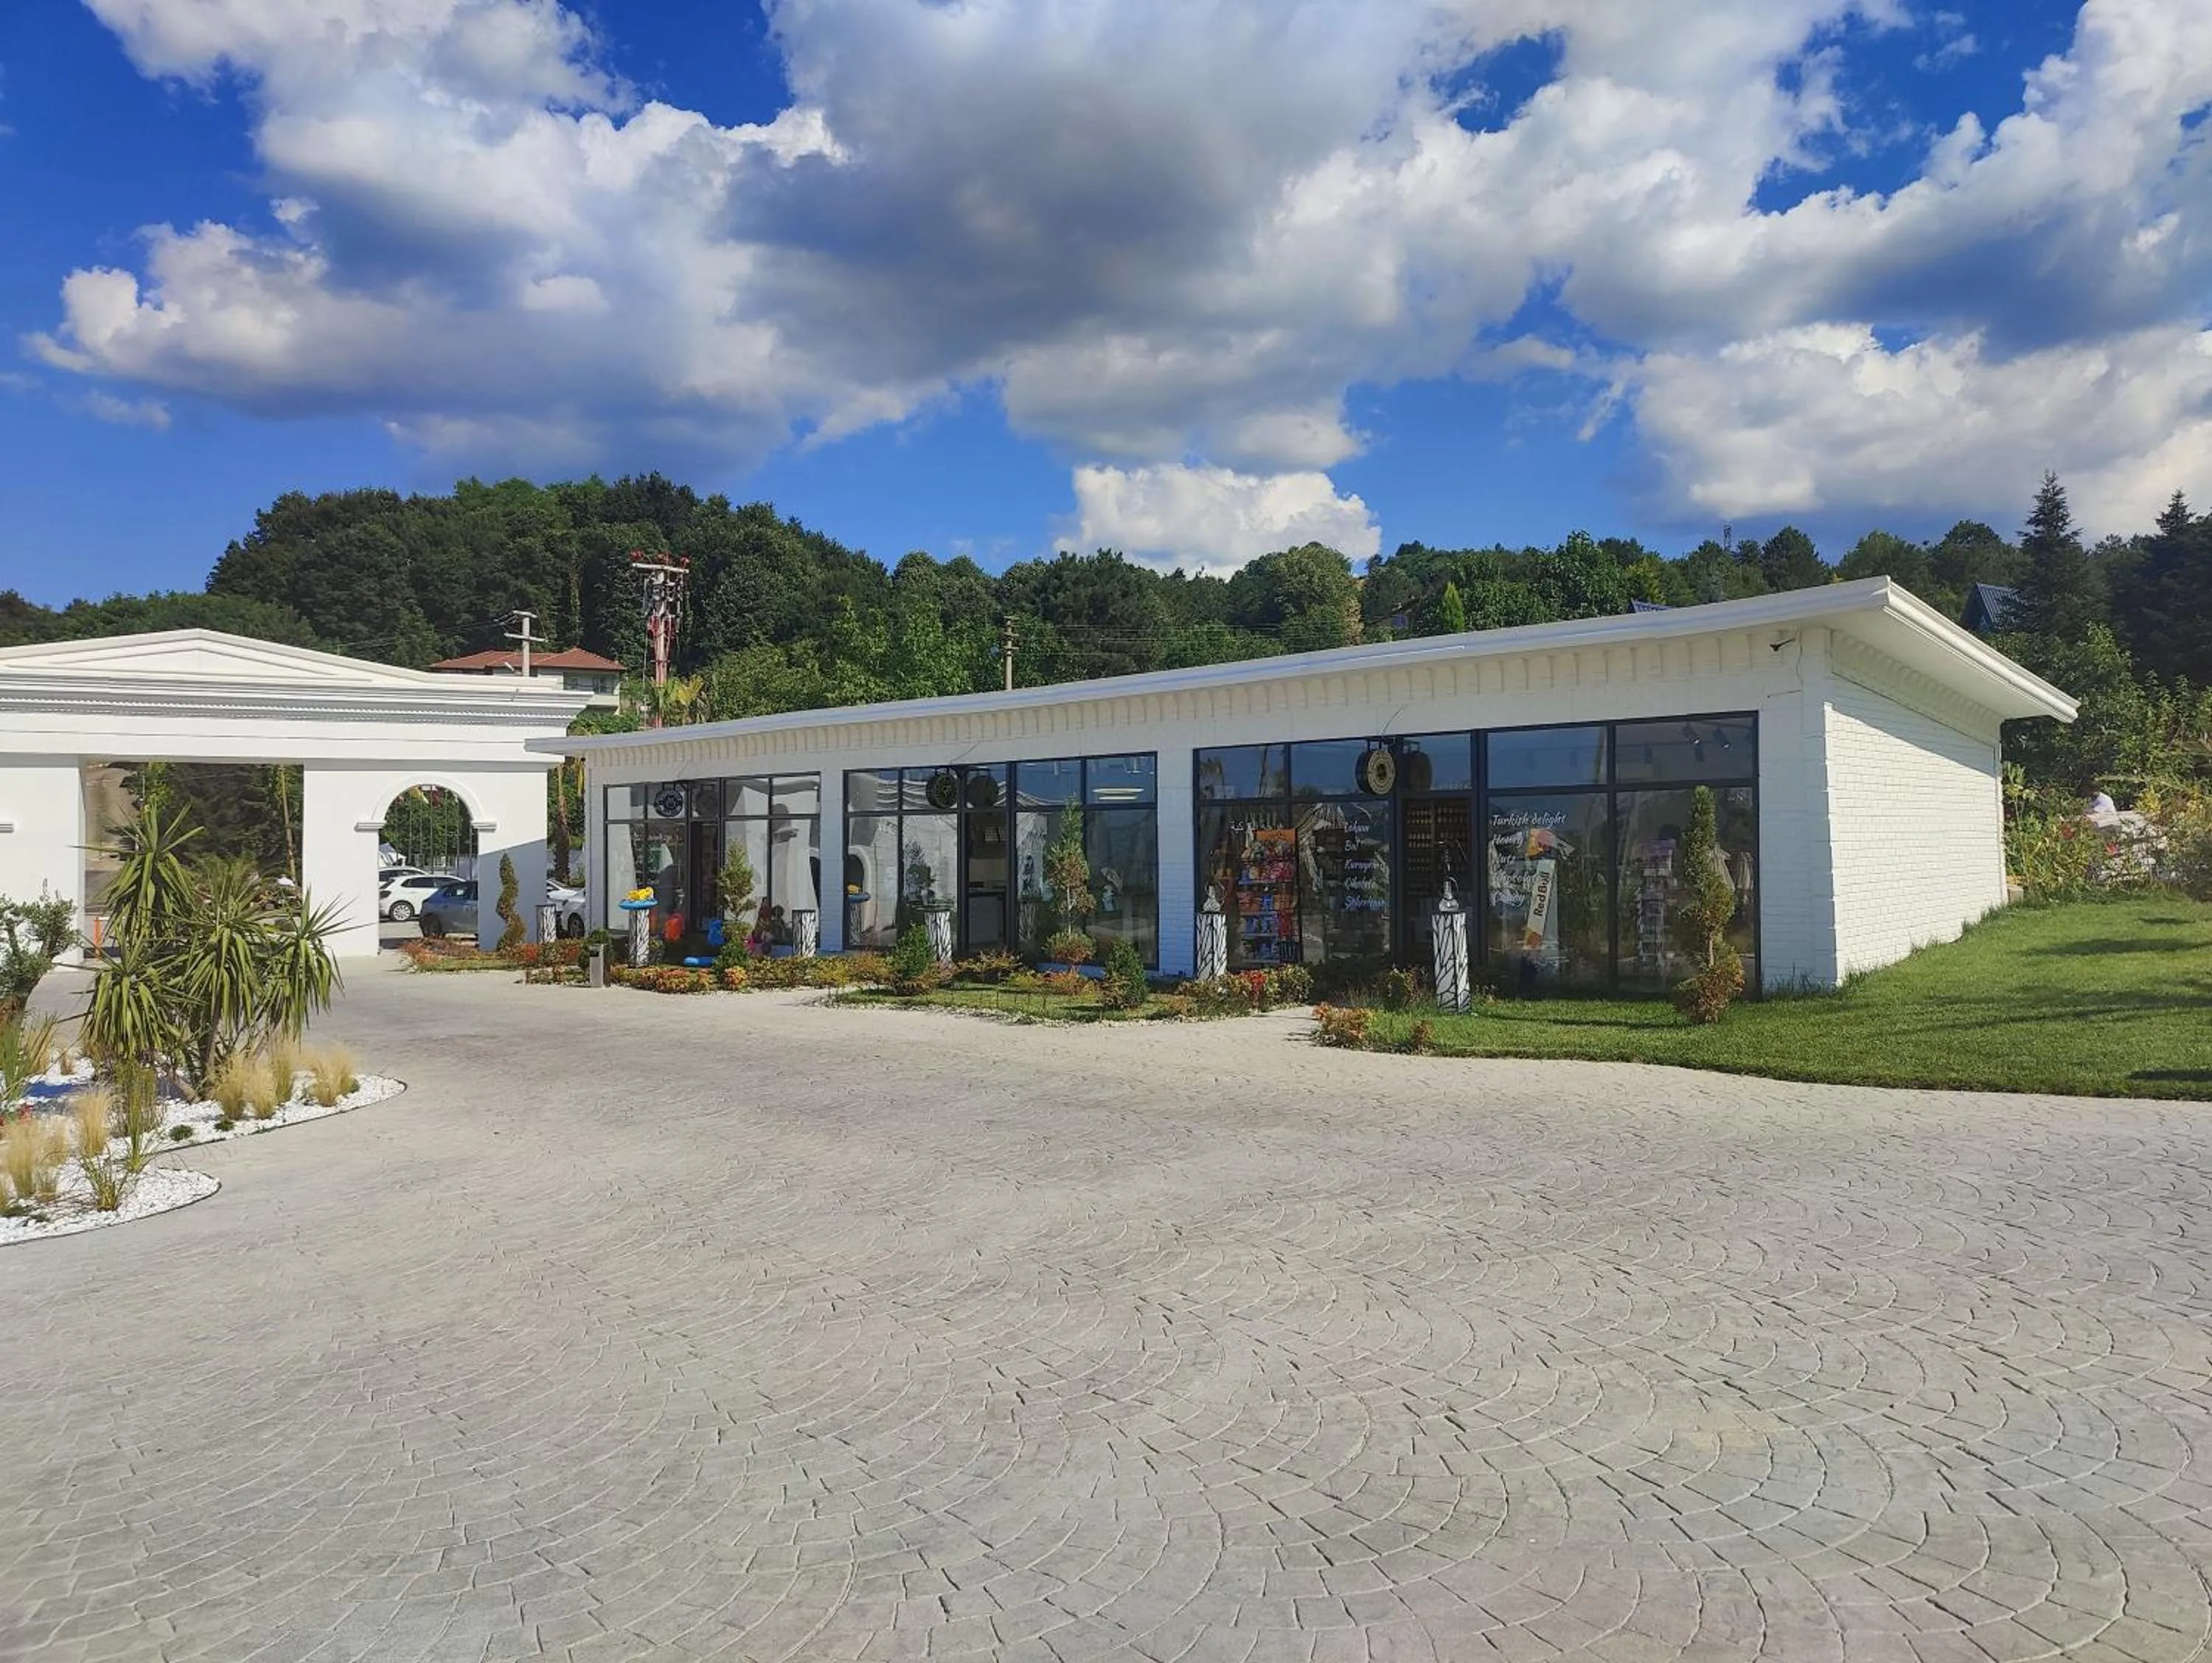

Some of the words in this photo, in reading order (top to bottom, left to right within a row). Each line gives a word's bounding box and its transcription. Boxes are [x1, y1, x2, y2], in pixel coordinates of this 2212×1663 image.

[1492, 813, 1529, 826] Turkish
[1531, 811, 1567, 827] delight
[1492, 834, 1523, 848] Honey
[1537, 871, 1550, 893] Bull
[1533, 893, 1547, 916] Red
